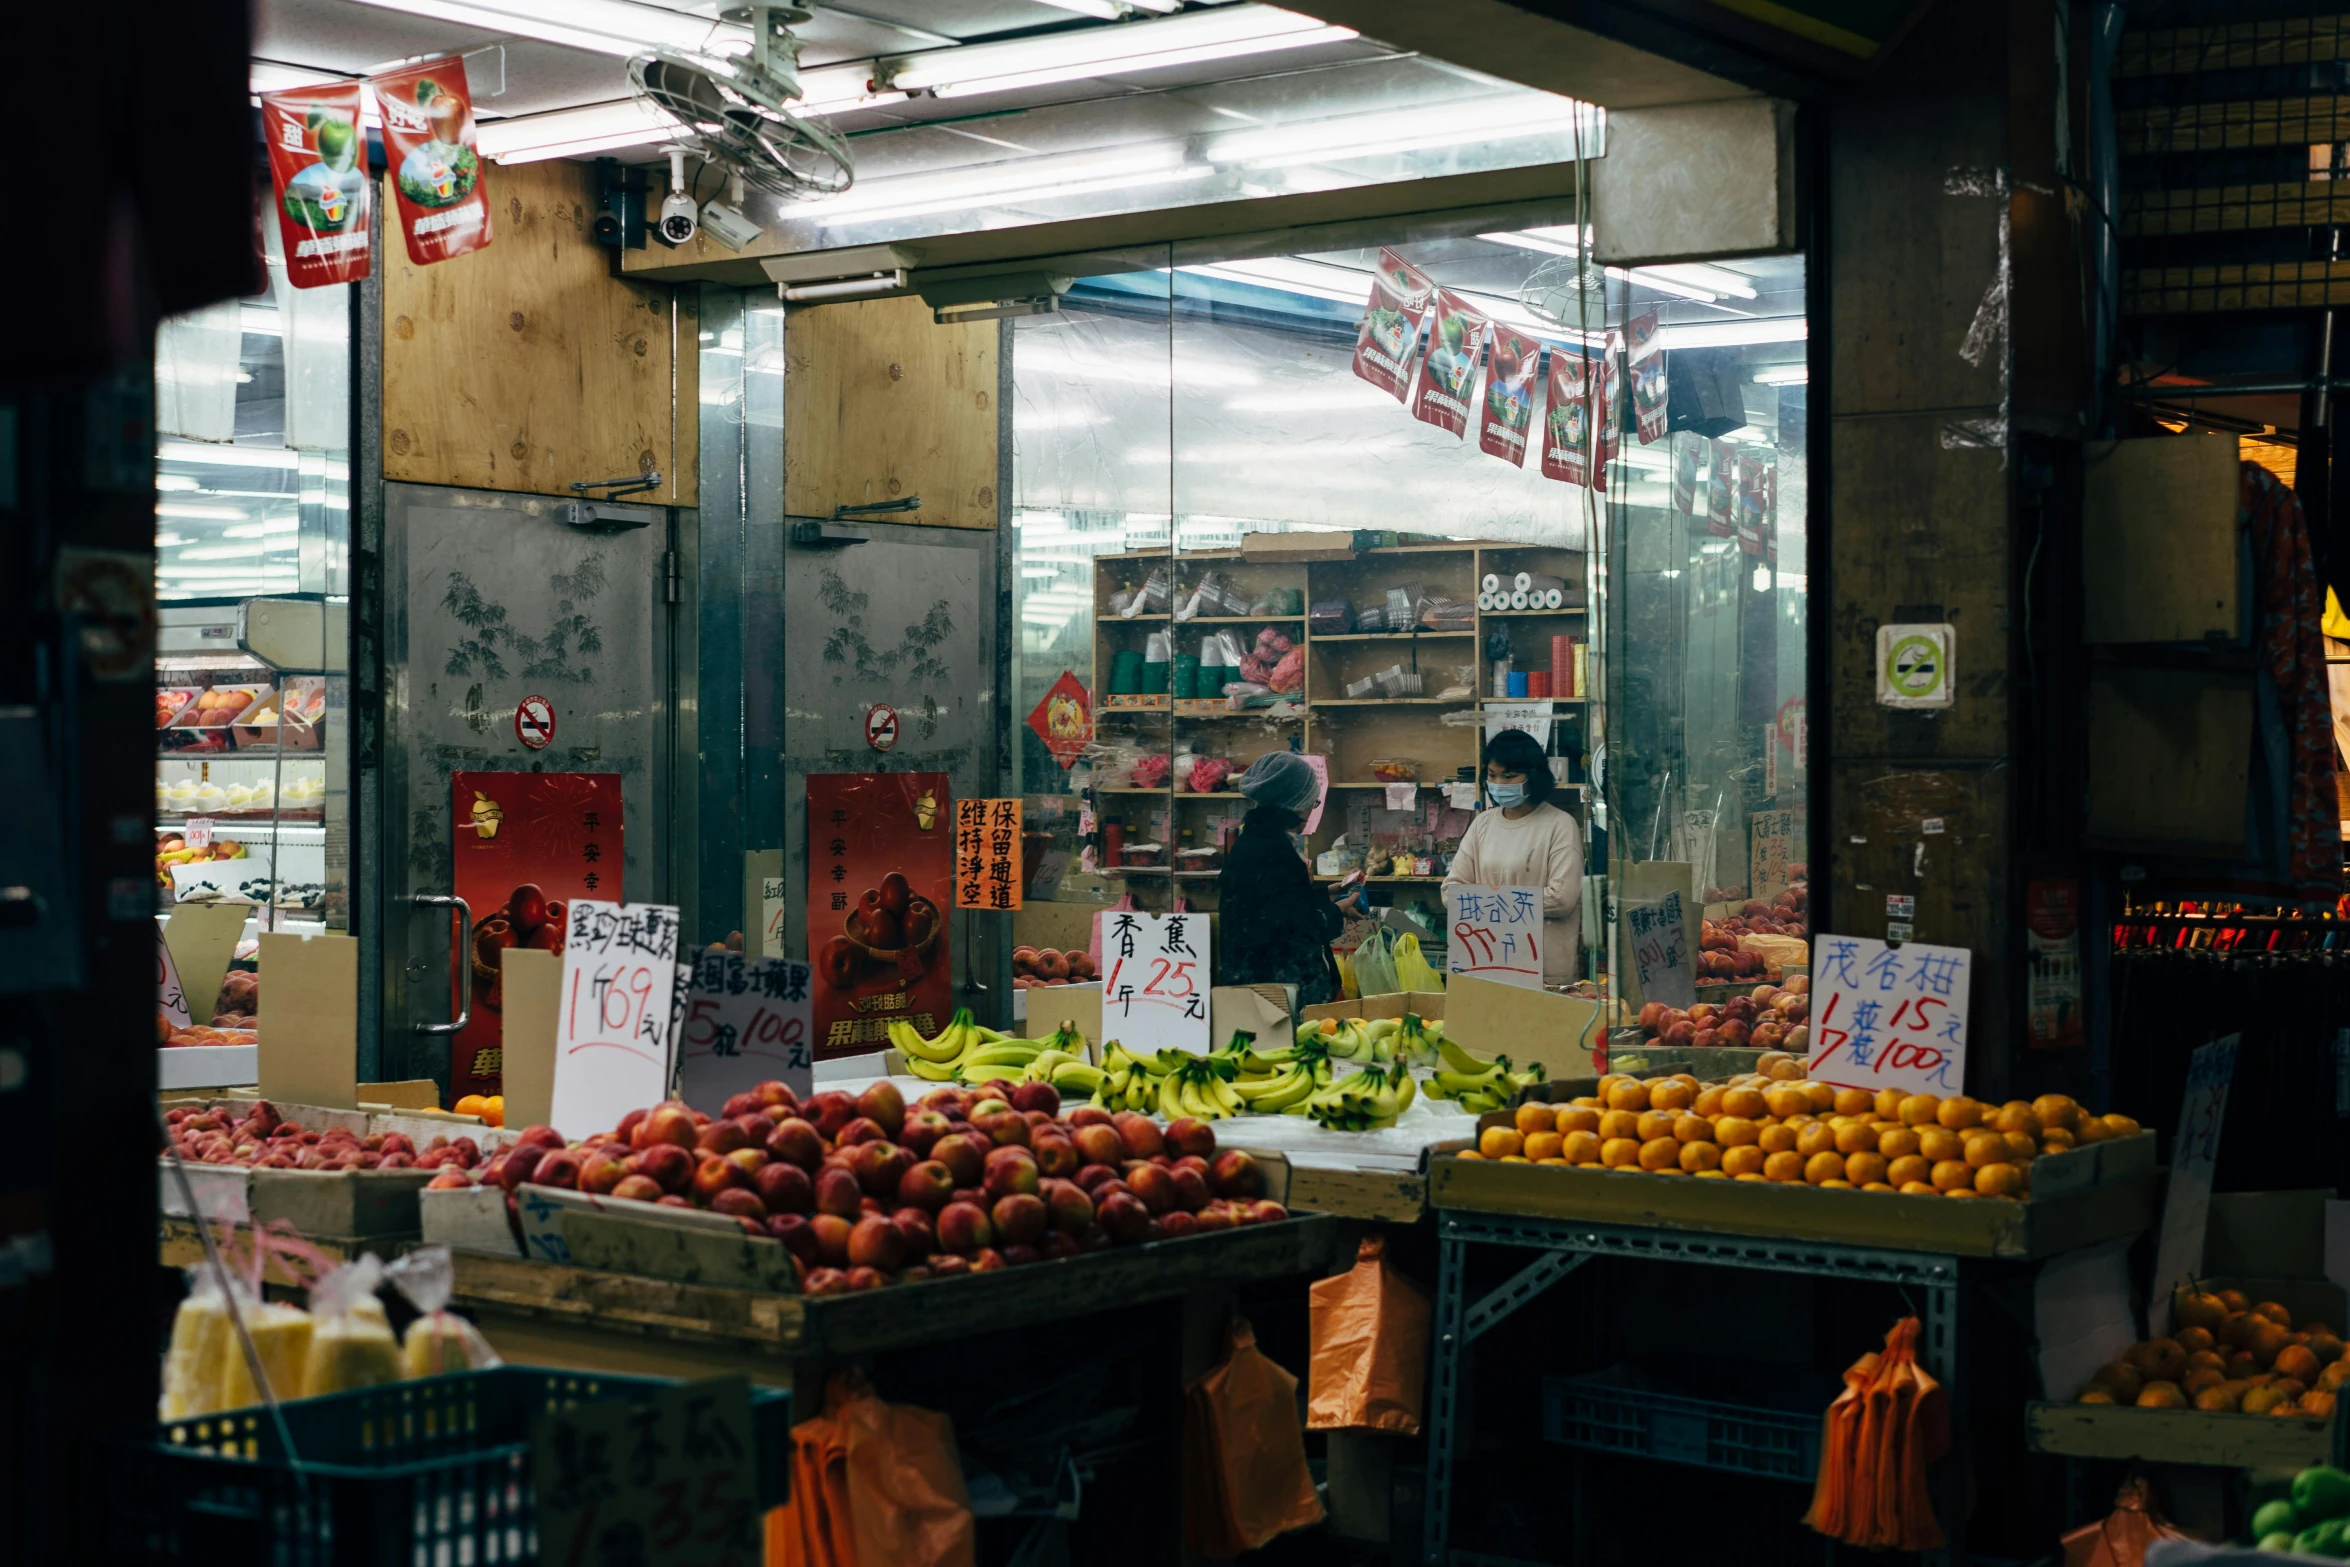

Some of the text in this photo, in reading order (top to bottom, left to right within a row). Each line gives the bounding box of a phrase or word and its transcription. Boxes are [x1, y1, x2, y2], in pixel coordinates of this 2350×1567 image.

[958, 801, 987, 906] 維持淨空
[988, 801, 1017, 910] 保留通道
[1111, 913, 1197, 959] 香蕉
[1818, 940, 1964, 996] 茂谷柑
